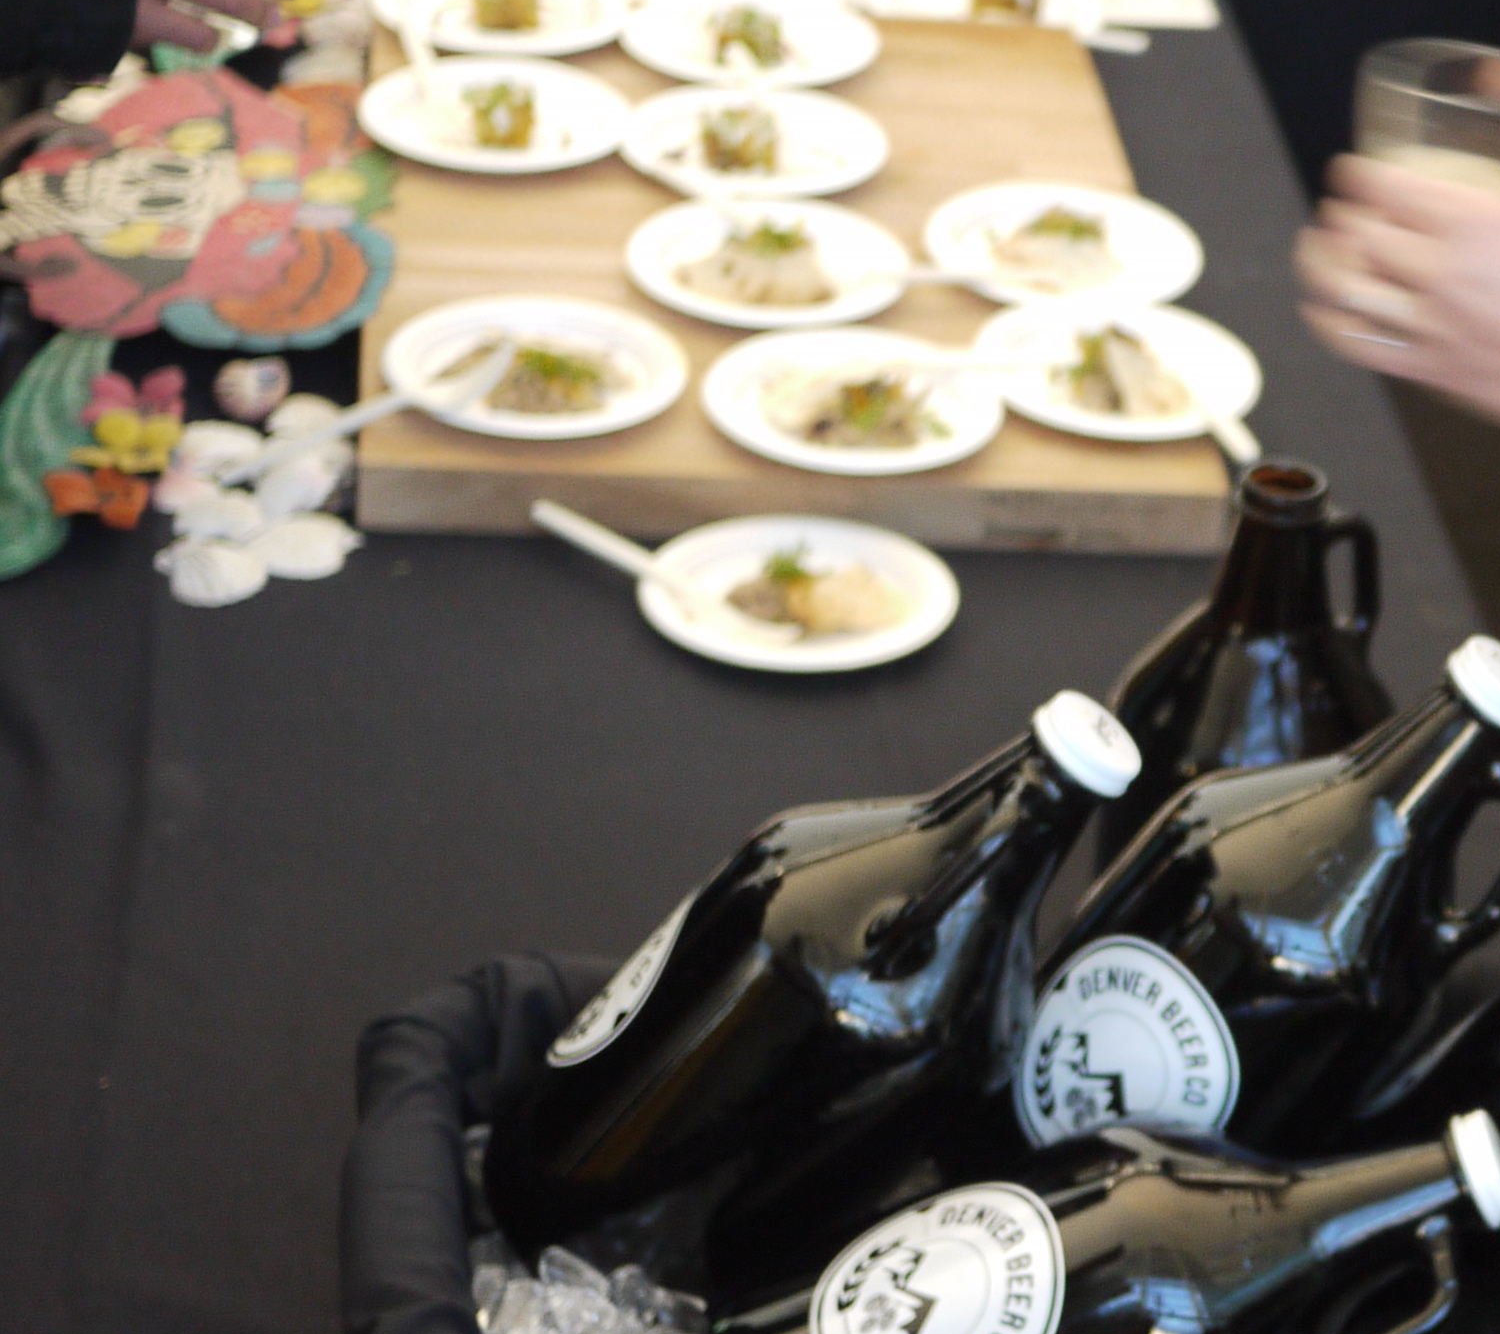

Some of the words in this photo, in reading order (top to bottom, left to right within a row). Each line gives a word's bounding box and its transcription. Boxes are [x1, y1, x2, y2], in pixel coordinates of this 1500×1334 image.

[1076, 966, 1163, 1006] DENVER
[1160, 998, 1209, 1069] BEER
[1181, 1077, 1212, 1107] CO
[938, 1202, 1025, 1255] DENVER
[999, 1250, 1034, 1333] BEER
